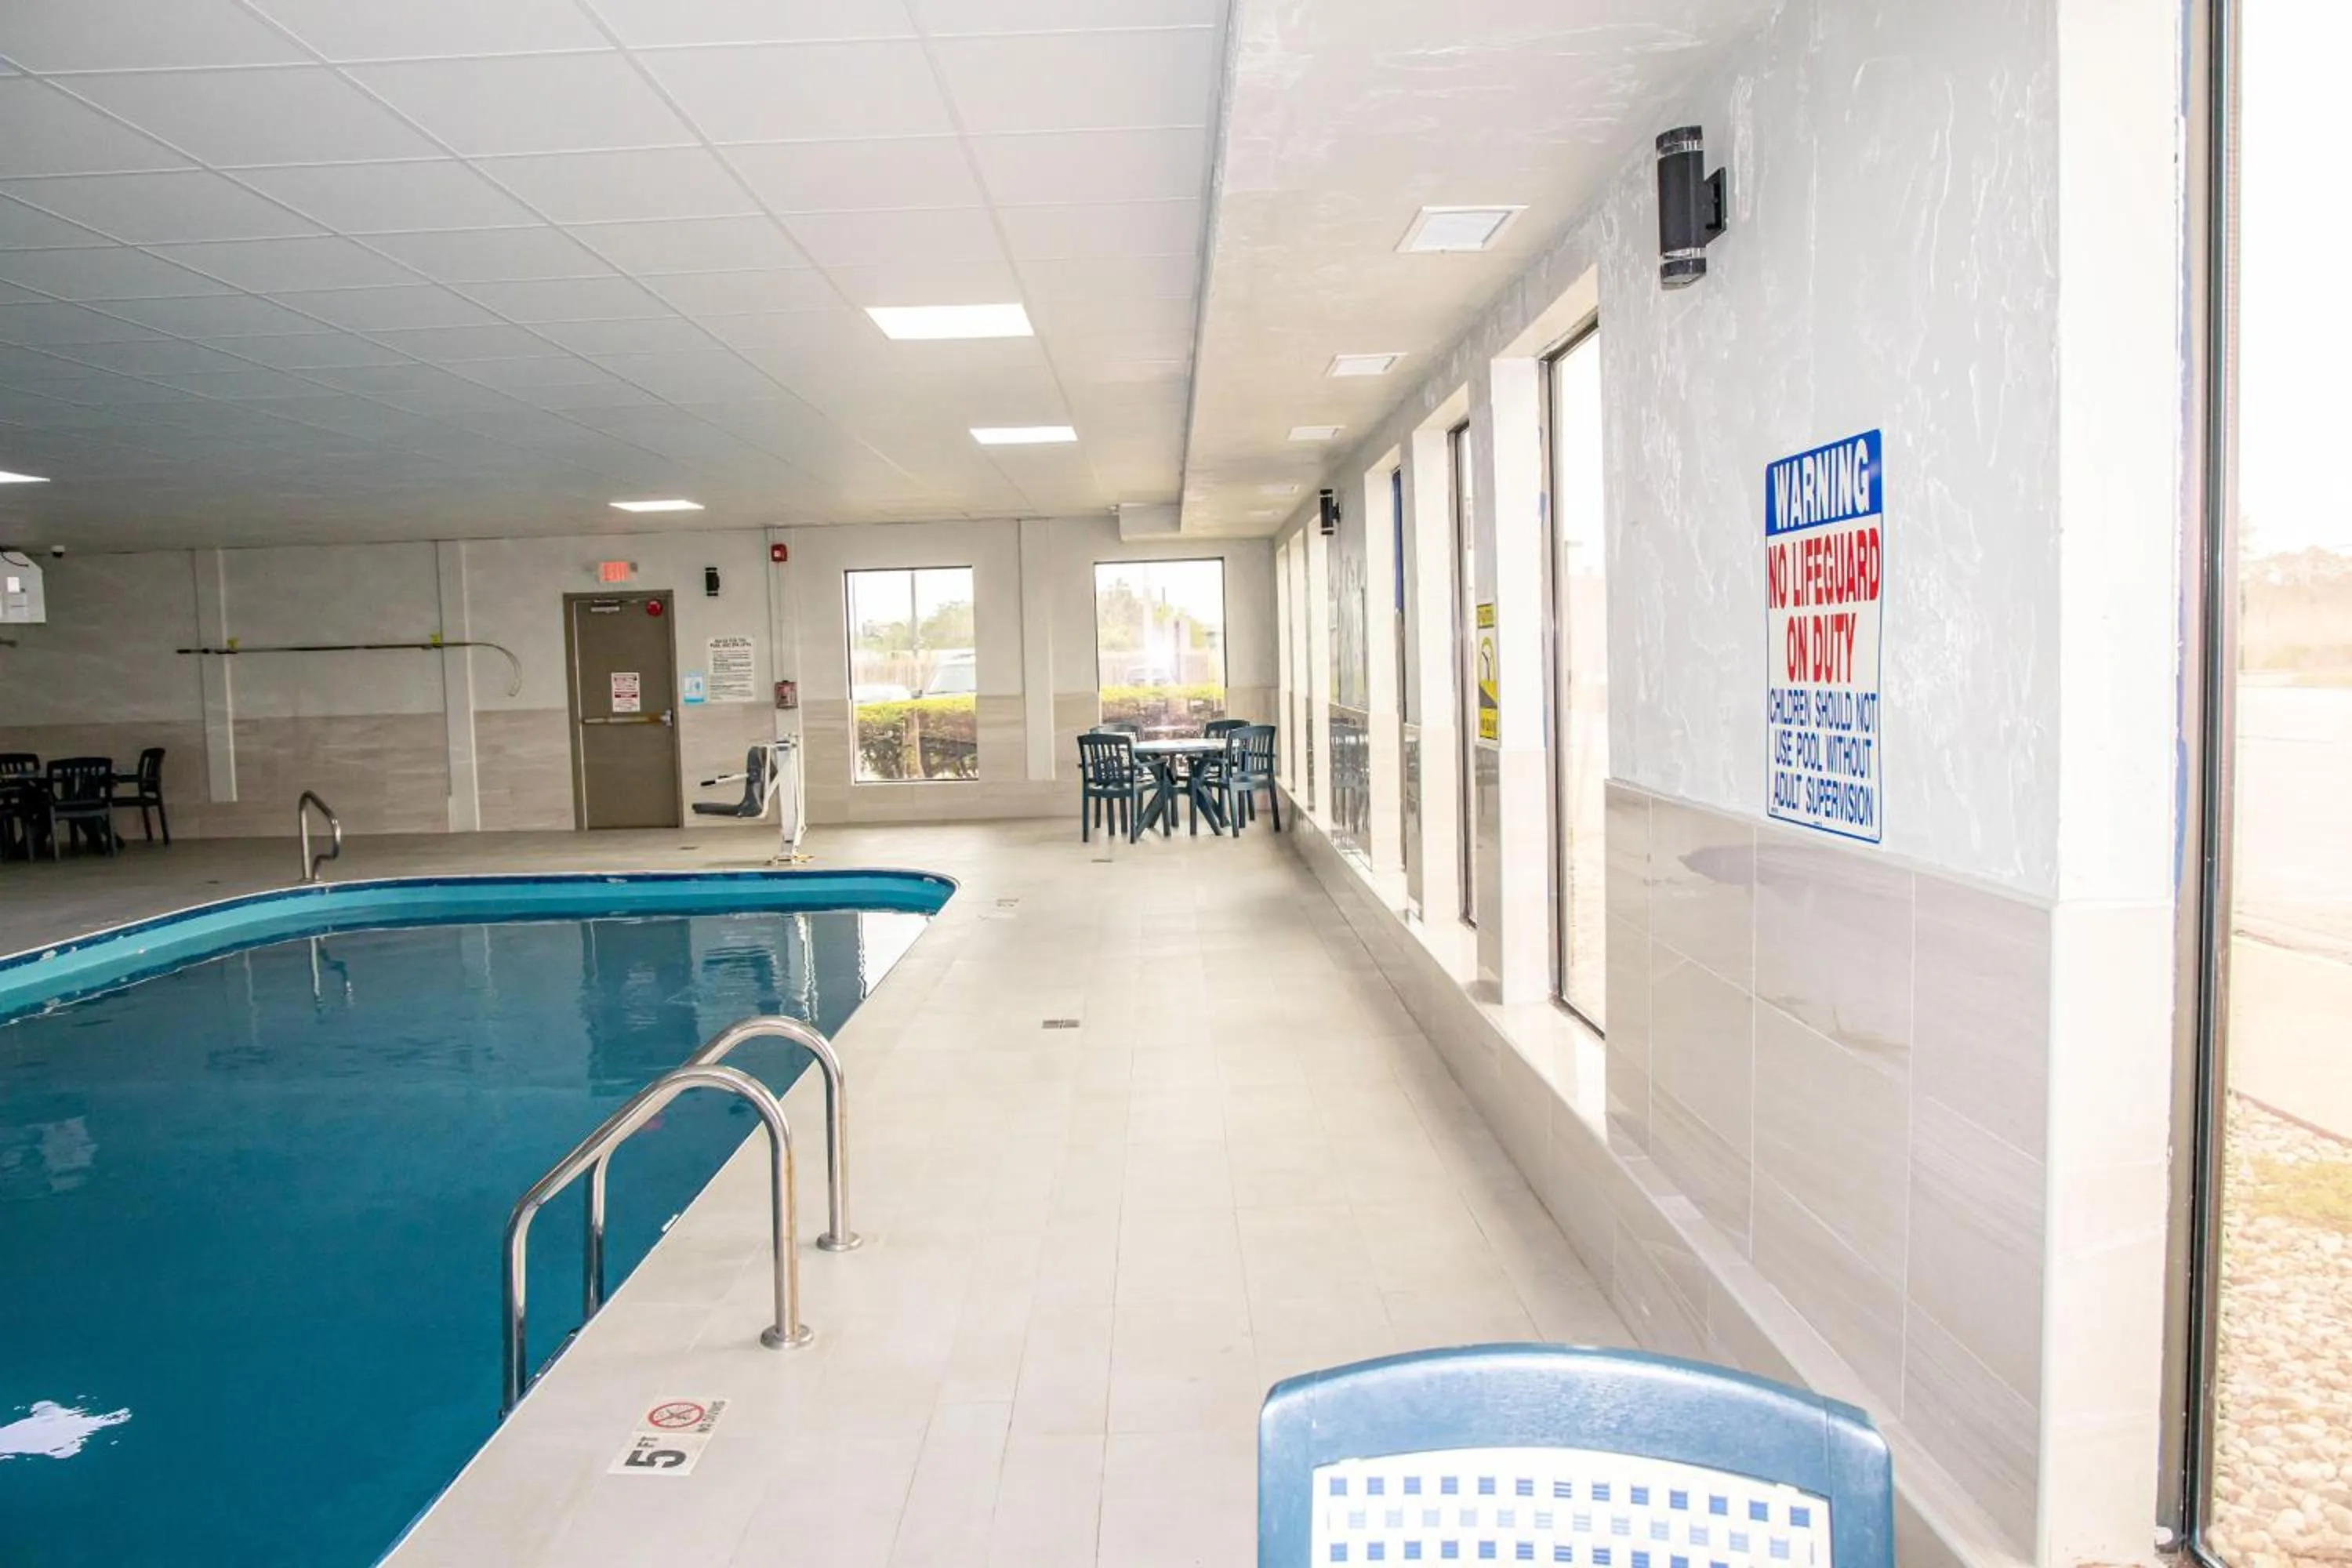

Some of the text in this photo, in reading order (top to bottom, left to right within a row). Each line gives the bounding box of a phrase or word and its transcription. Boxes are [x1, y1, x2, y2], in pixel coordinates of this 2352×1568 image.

[1773, 438, 1870, 530] WARNING
[1768, 528, 1880, 609] NO LIFEGUARD
[1787, 613, 1857, 684] ON DUTY
[1770, 688, 1877, 732] CHILDREN SHOULD NOT
[1775, 729, 1872, 779] USE POOL WITHOUT
[1773, 771, 1874, 828] ADULT SUPERVISION
[624, 1436, 687, 1468] 5 FT
